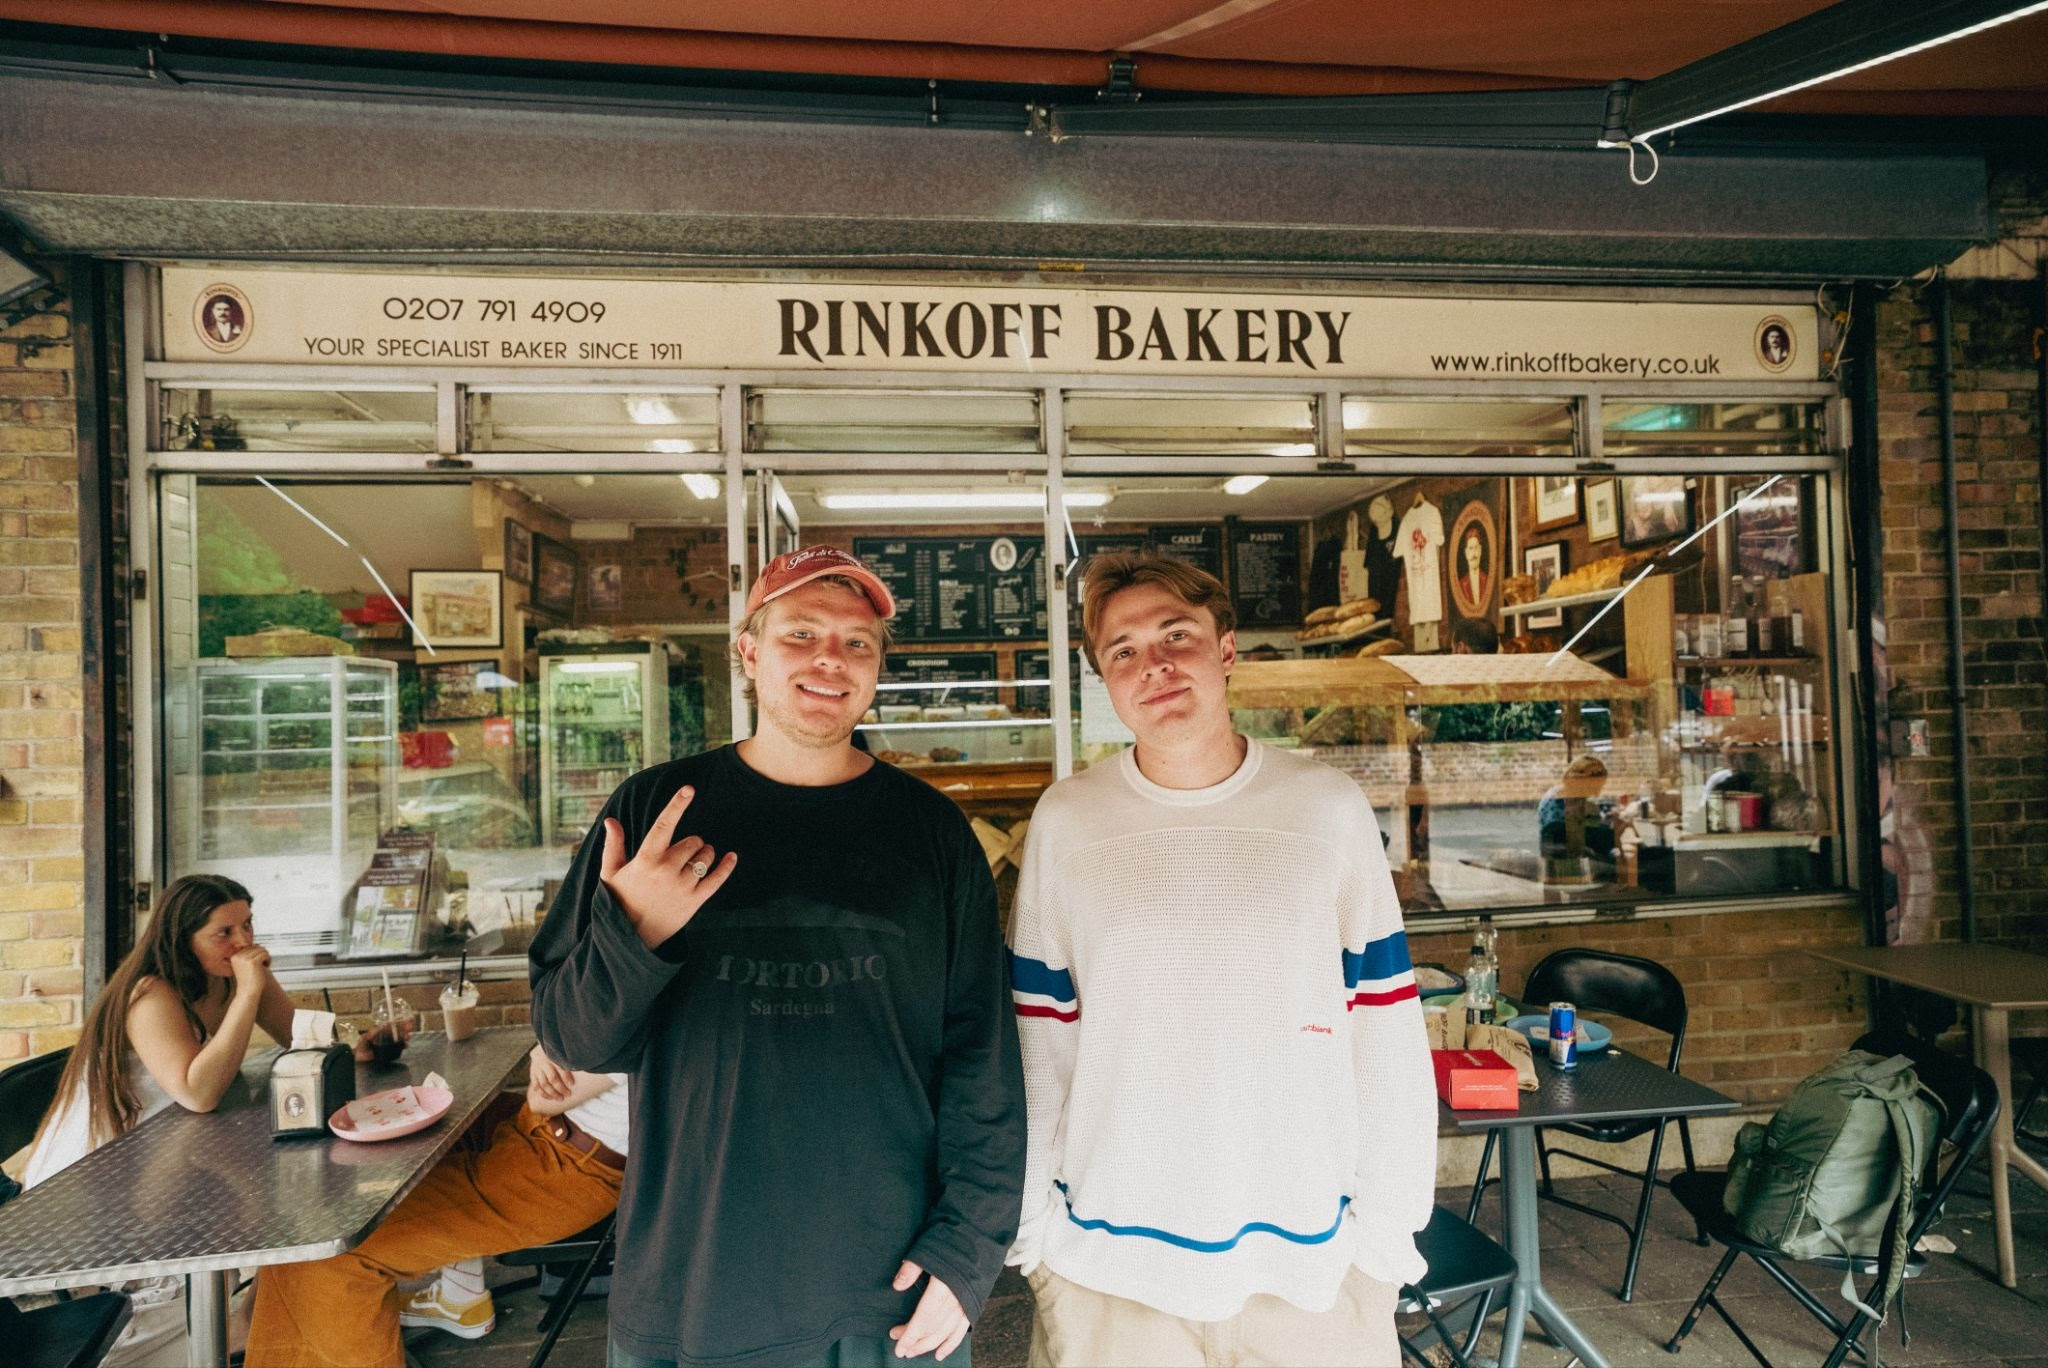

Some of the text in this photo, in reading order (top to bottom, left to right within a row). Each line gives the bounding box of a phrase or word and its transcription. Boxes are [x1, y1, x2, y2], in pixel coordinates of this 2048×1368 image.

[384, 297, 606, 324] 0207 791 4909
[777, 298, 1353, 370] RINKOFF BAKERY
[303, 337, 682, 360] YOUR SPECIALIST BAKER SINCE 1911
[1431, 352, 1720, 378] www.rinkoffbakery.co.uk
[749, 998, 836, 1018] Sardegna
